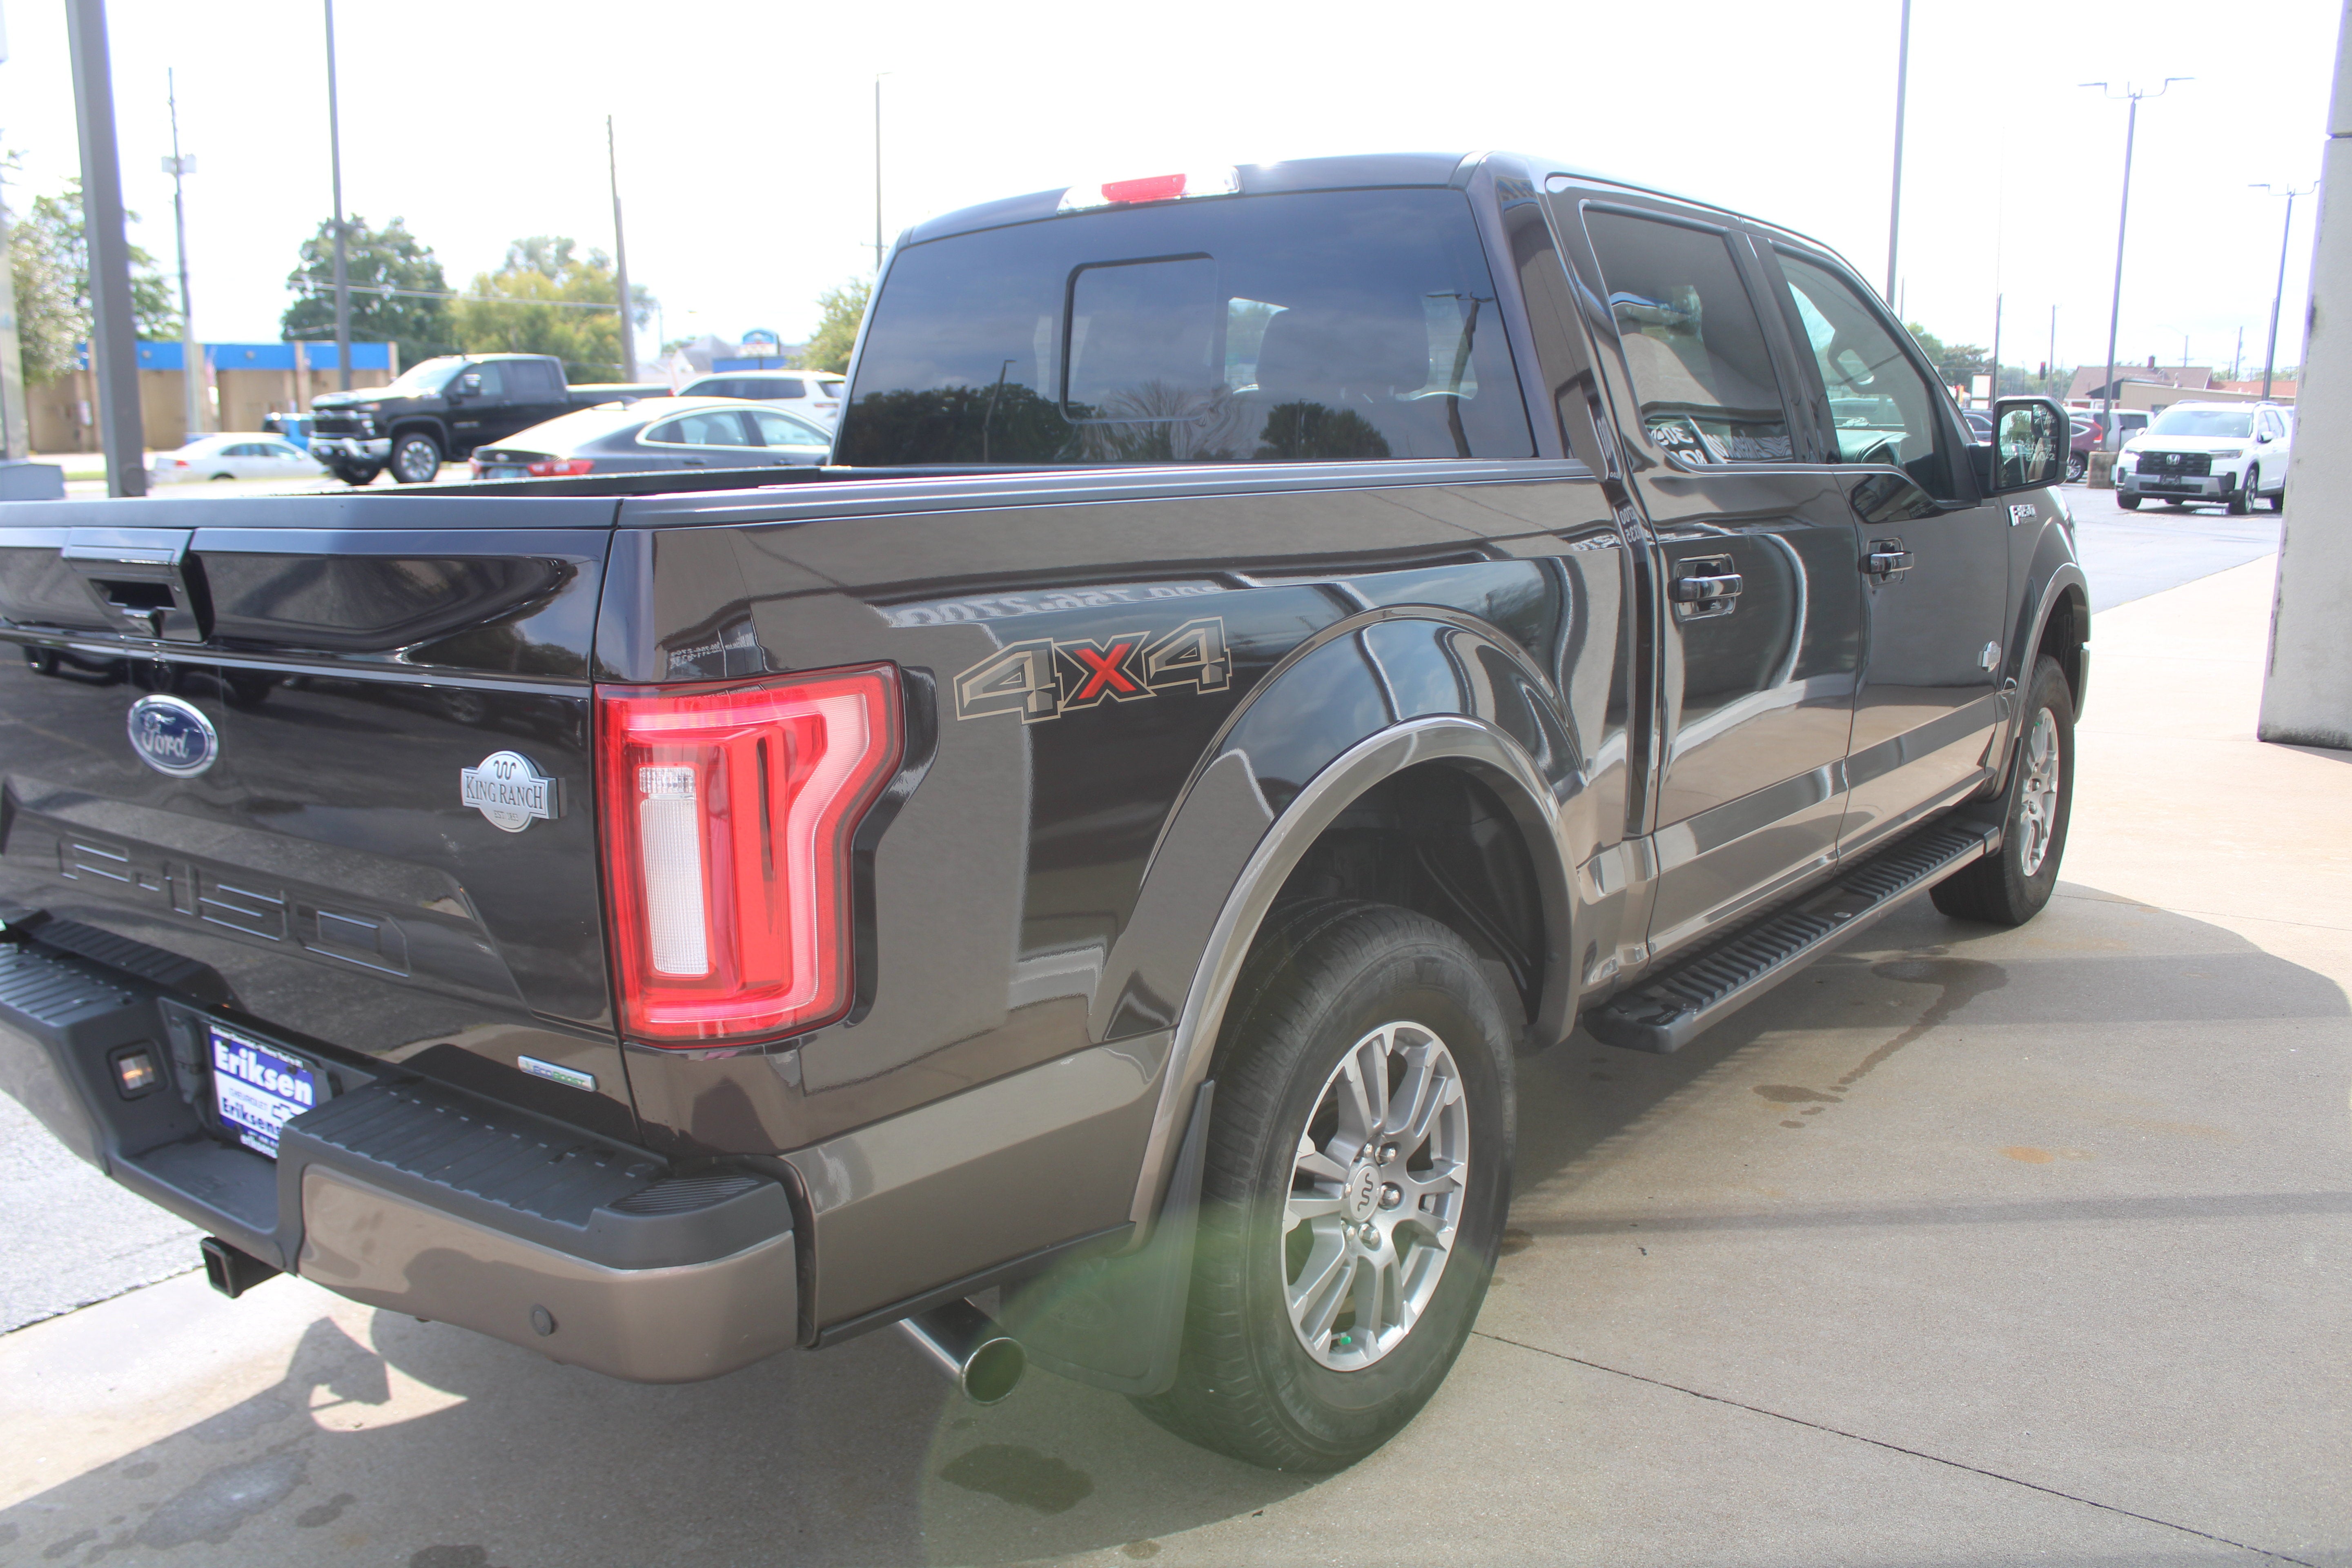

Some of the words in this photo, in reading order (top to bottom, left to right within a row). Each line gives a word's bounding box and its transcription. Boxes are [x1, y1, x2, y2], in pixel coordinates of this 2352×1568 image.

[141, 711, 189, 759] Ford
[465, 775, 496, 802] KING
[499, 783, 543, 809] RANCH
[57, 830, 411, 978] F-150
[214, 1039, 313, 1106] Eriksen
